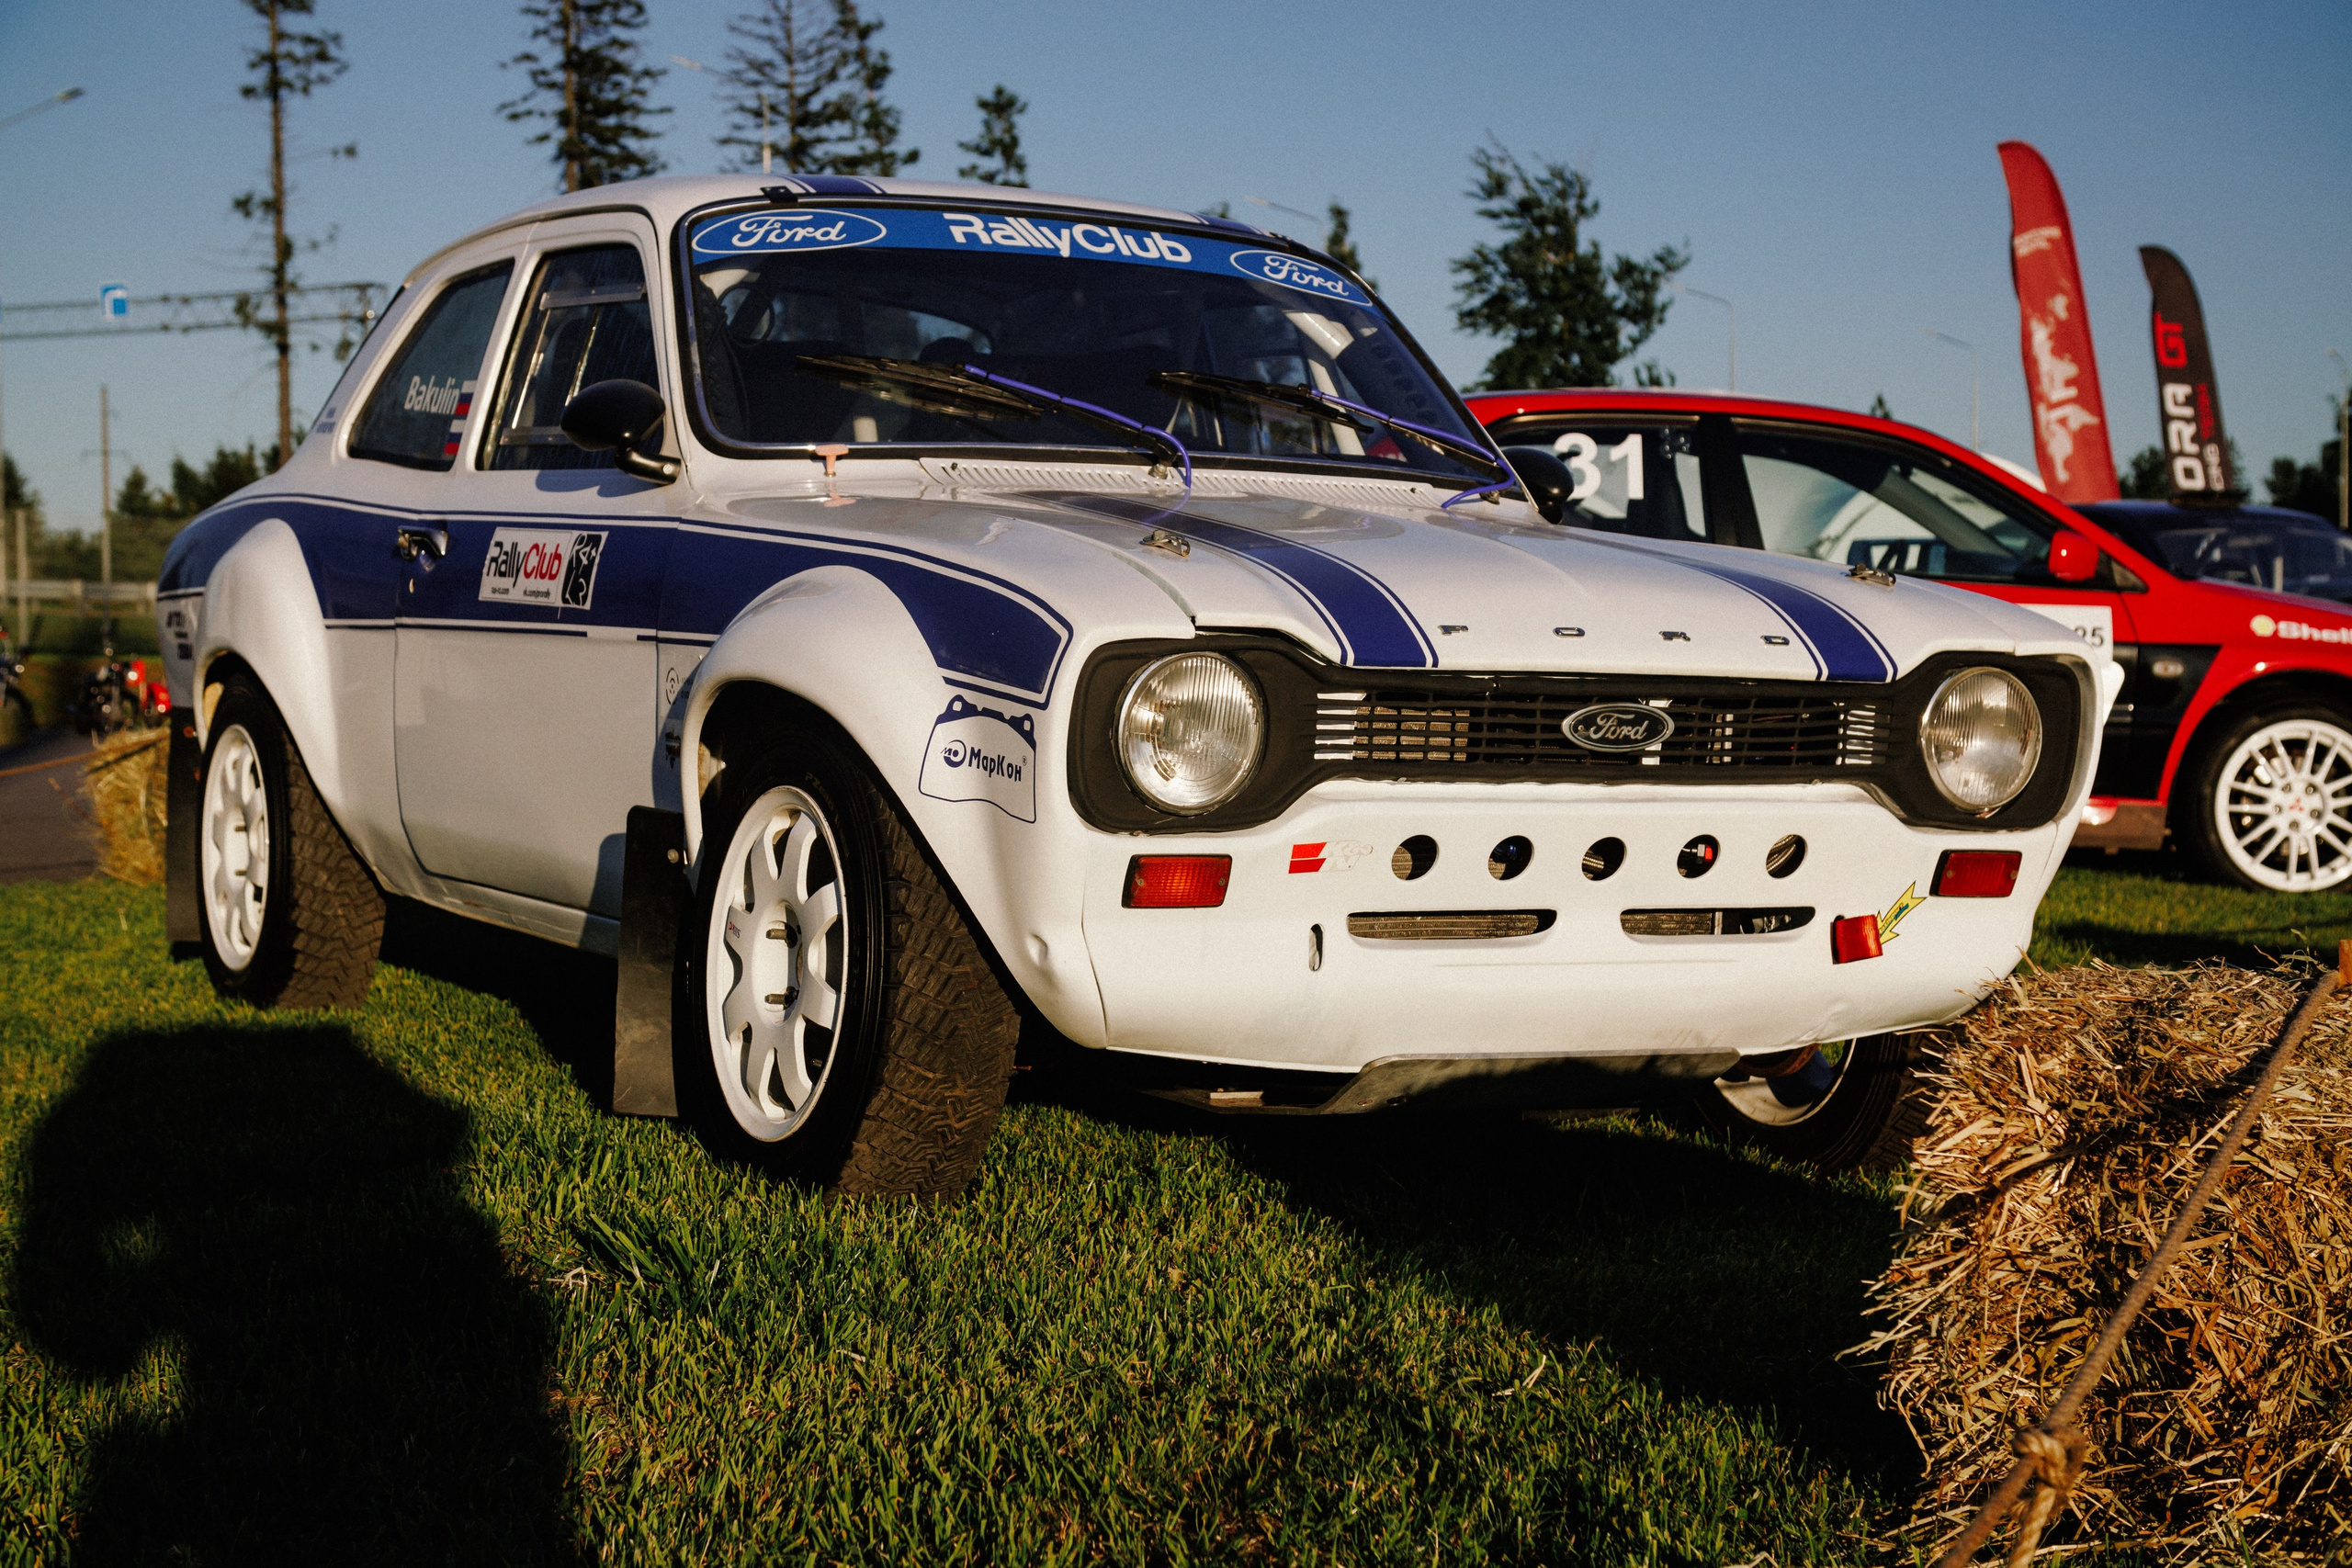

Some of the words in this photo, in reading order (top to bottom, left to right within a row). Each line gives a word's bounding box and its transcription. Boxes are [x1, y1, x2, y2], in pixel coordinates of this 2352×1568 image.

[731, 215, 847, 247] Ford
[943, 212, 1193, 264] RallyClub
[1263, 255, 1349, 296] Ford
[2154, 310, 2188, 367] GT
[404, 375, 460, 415] Bakulin
[2163, 382, 2206, 492] ORA
[1554, 432, 1645, 501] 31
[486, 540, 562, 589] RallyClub
[1438, 625, 1791, 646] FORD
[1589, 712, 1649, 740] Ford
[967, 746, 1022, 783] МарКон
